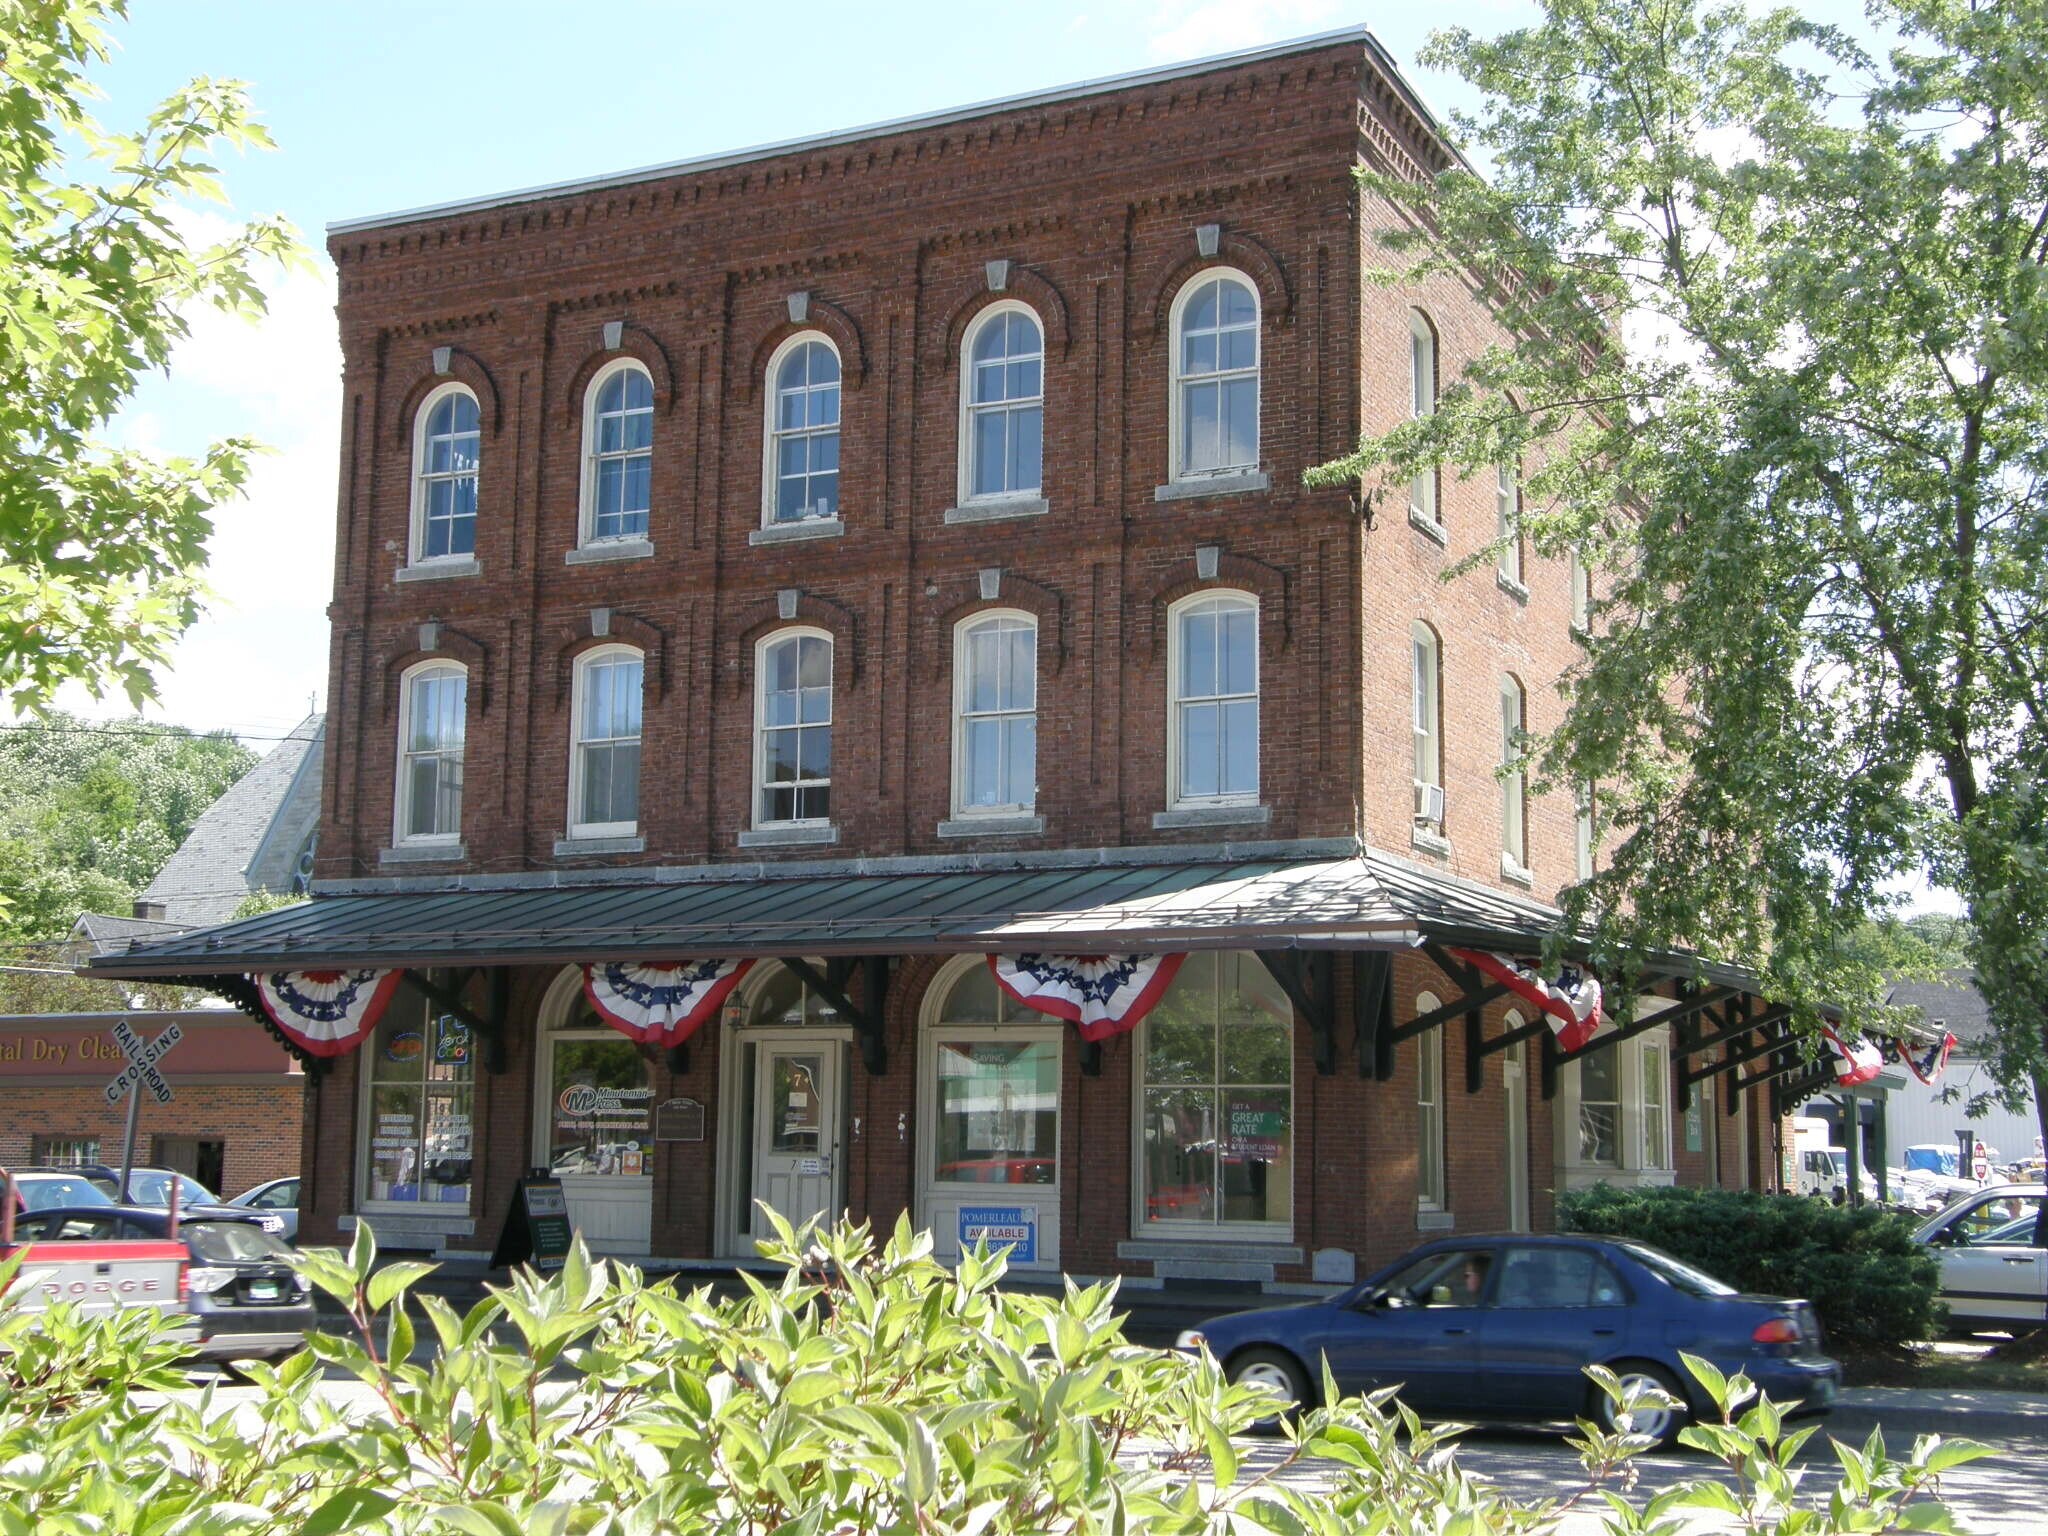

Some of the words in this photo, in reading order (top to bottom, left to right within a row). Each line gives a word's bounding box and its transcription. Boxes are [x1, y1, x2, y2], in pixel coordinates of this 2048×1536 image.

[33, 1039, 68, 1065] Dry
[79, 1037, 126, 1059] Clea
[107, 1026, 180, 1100] CROSSING
[794, 1074, 802, 1087] 7
[598, 1087, 649, 1099] Minuteman
[1232, 1112, 1265, 1123] GREAT
[1232, 1124, 1257, 1136] RATE
[970, 1228, 1025, 1238] AVILABLE
[42, 1280, 159, 1295] DODGE
